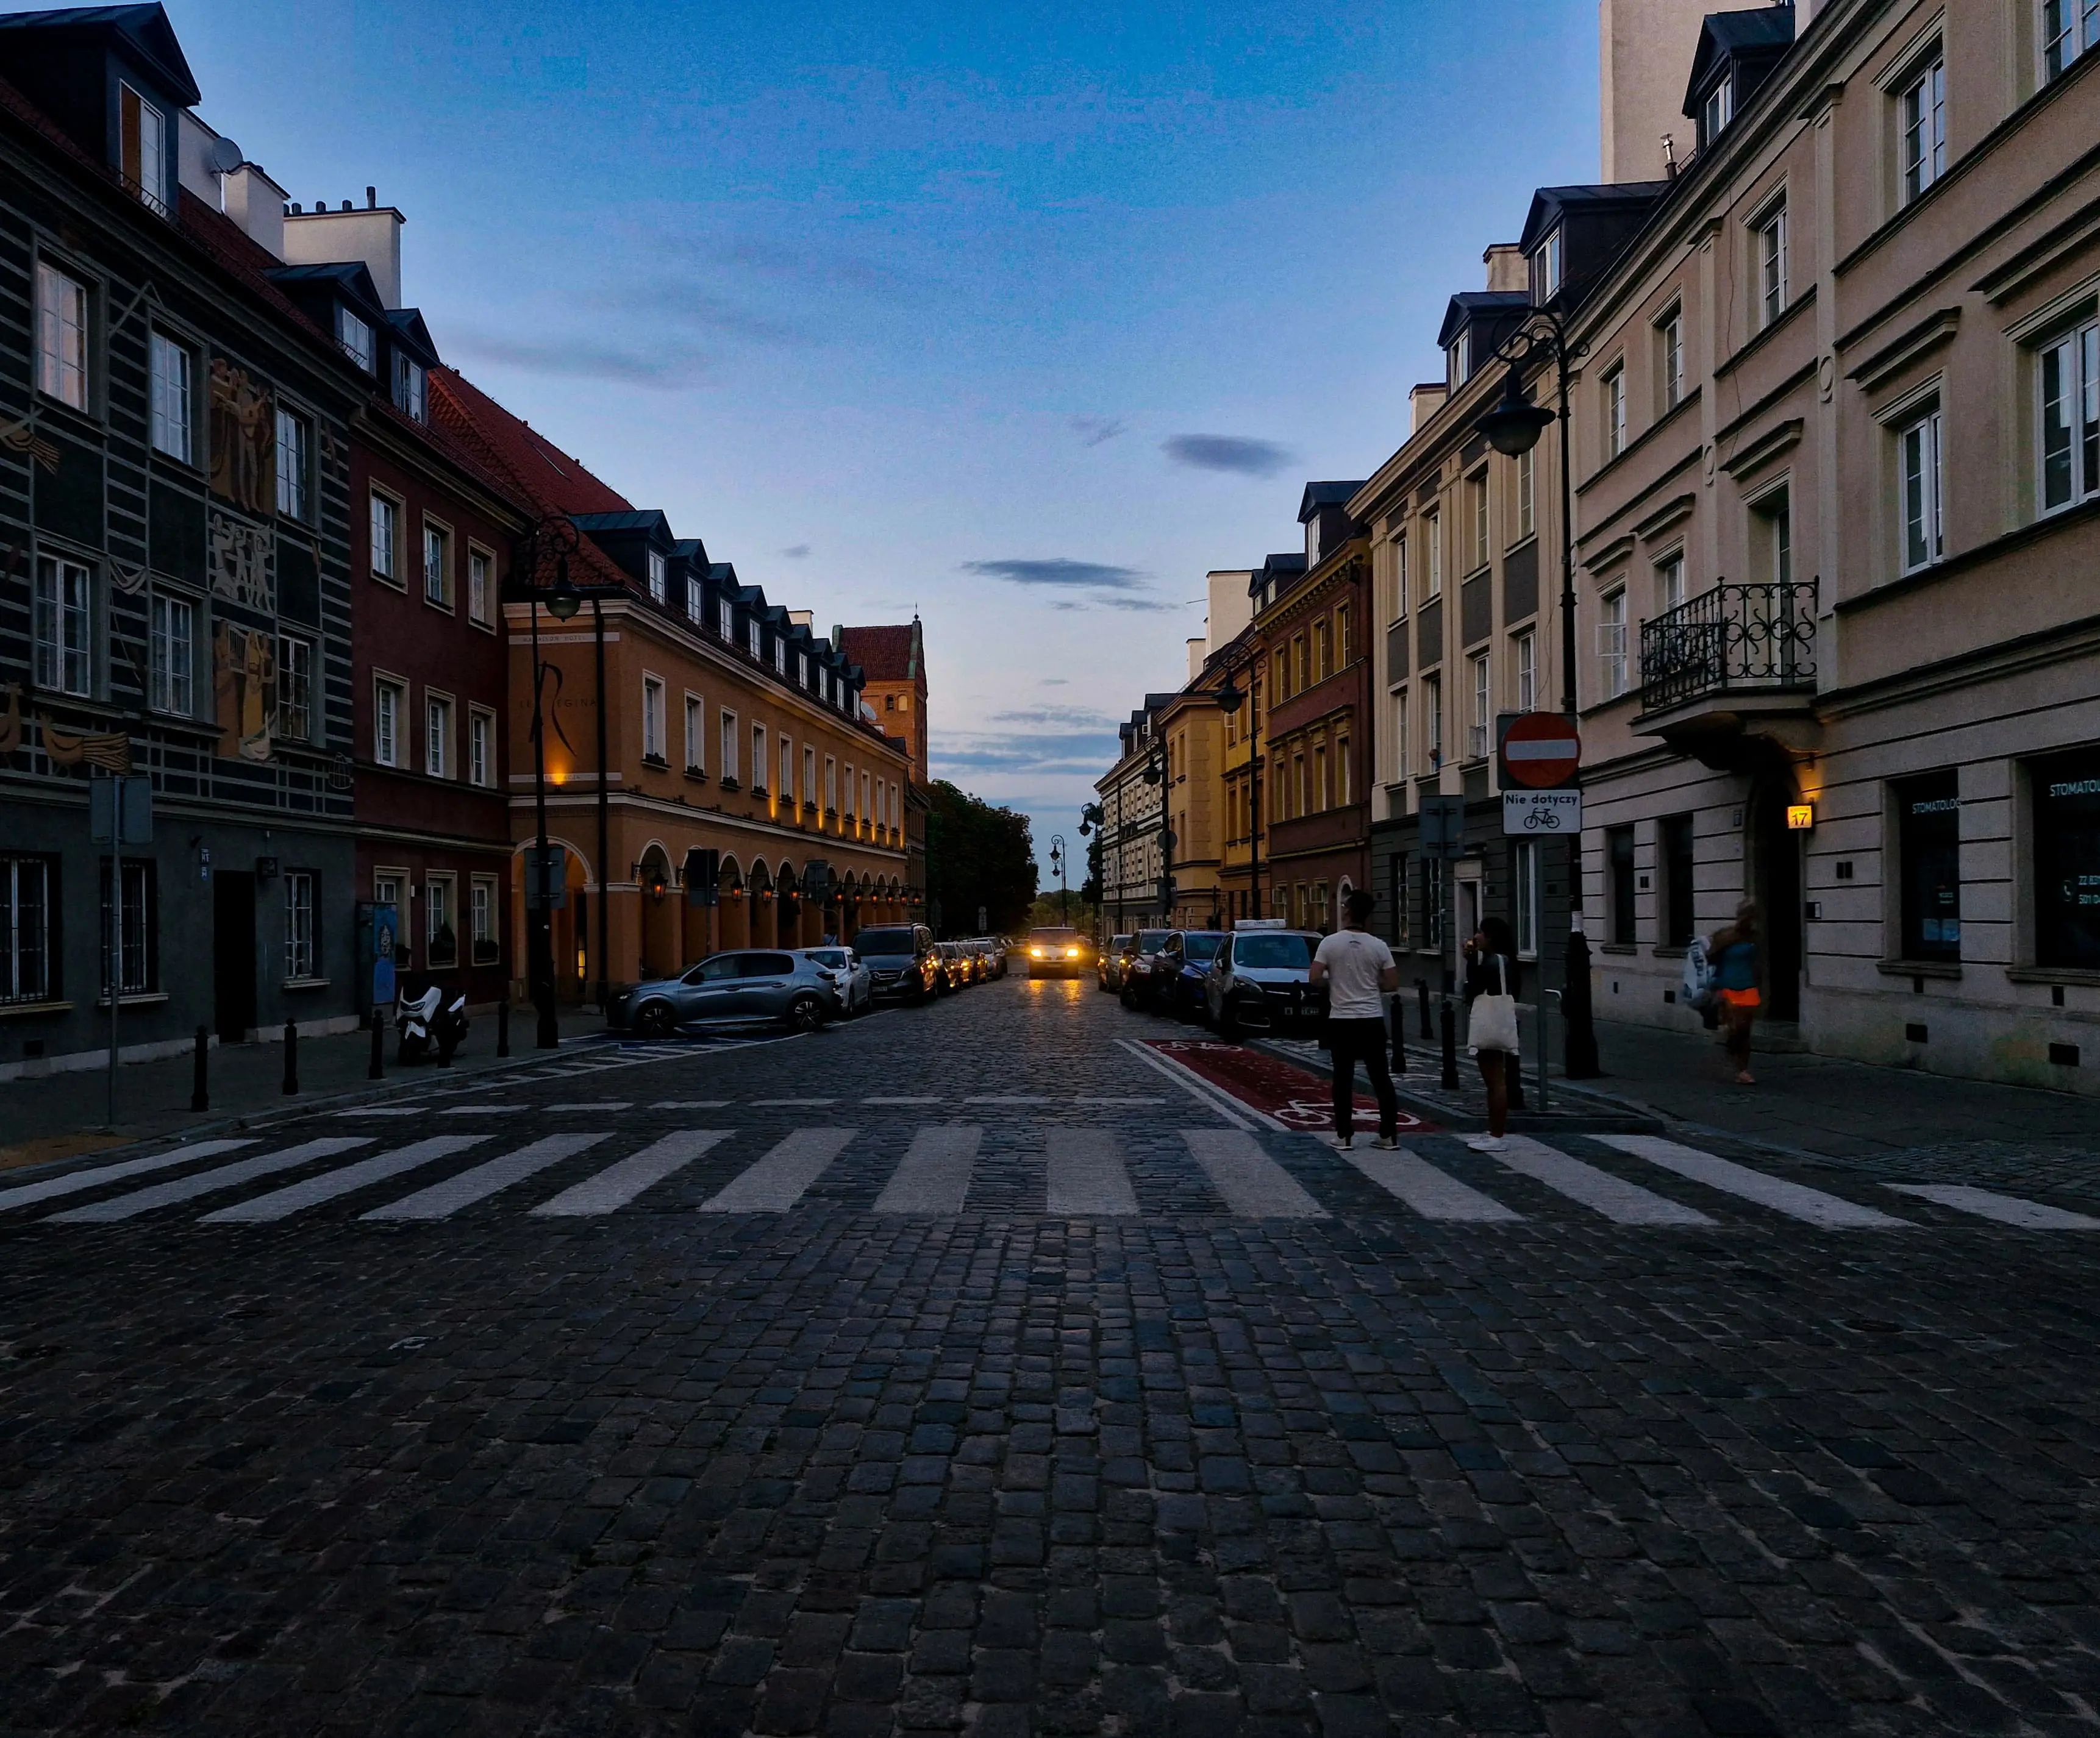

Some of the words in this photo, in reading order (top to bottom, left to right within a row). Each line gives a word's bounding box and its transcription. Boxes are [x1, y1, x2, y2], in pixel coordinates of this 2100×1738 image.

[1506, 794, 1526, 804] Nie
[1532, 794, 1577, 806] dotyczy
[1792, 813, 1808, 825] 17
